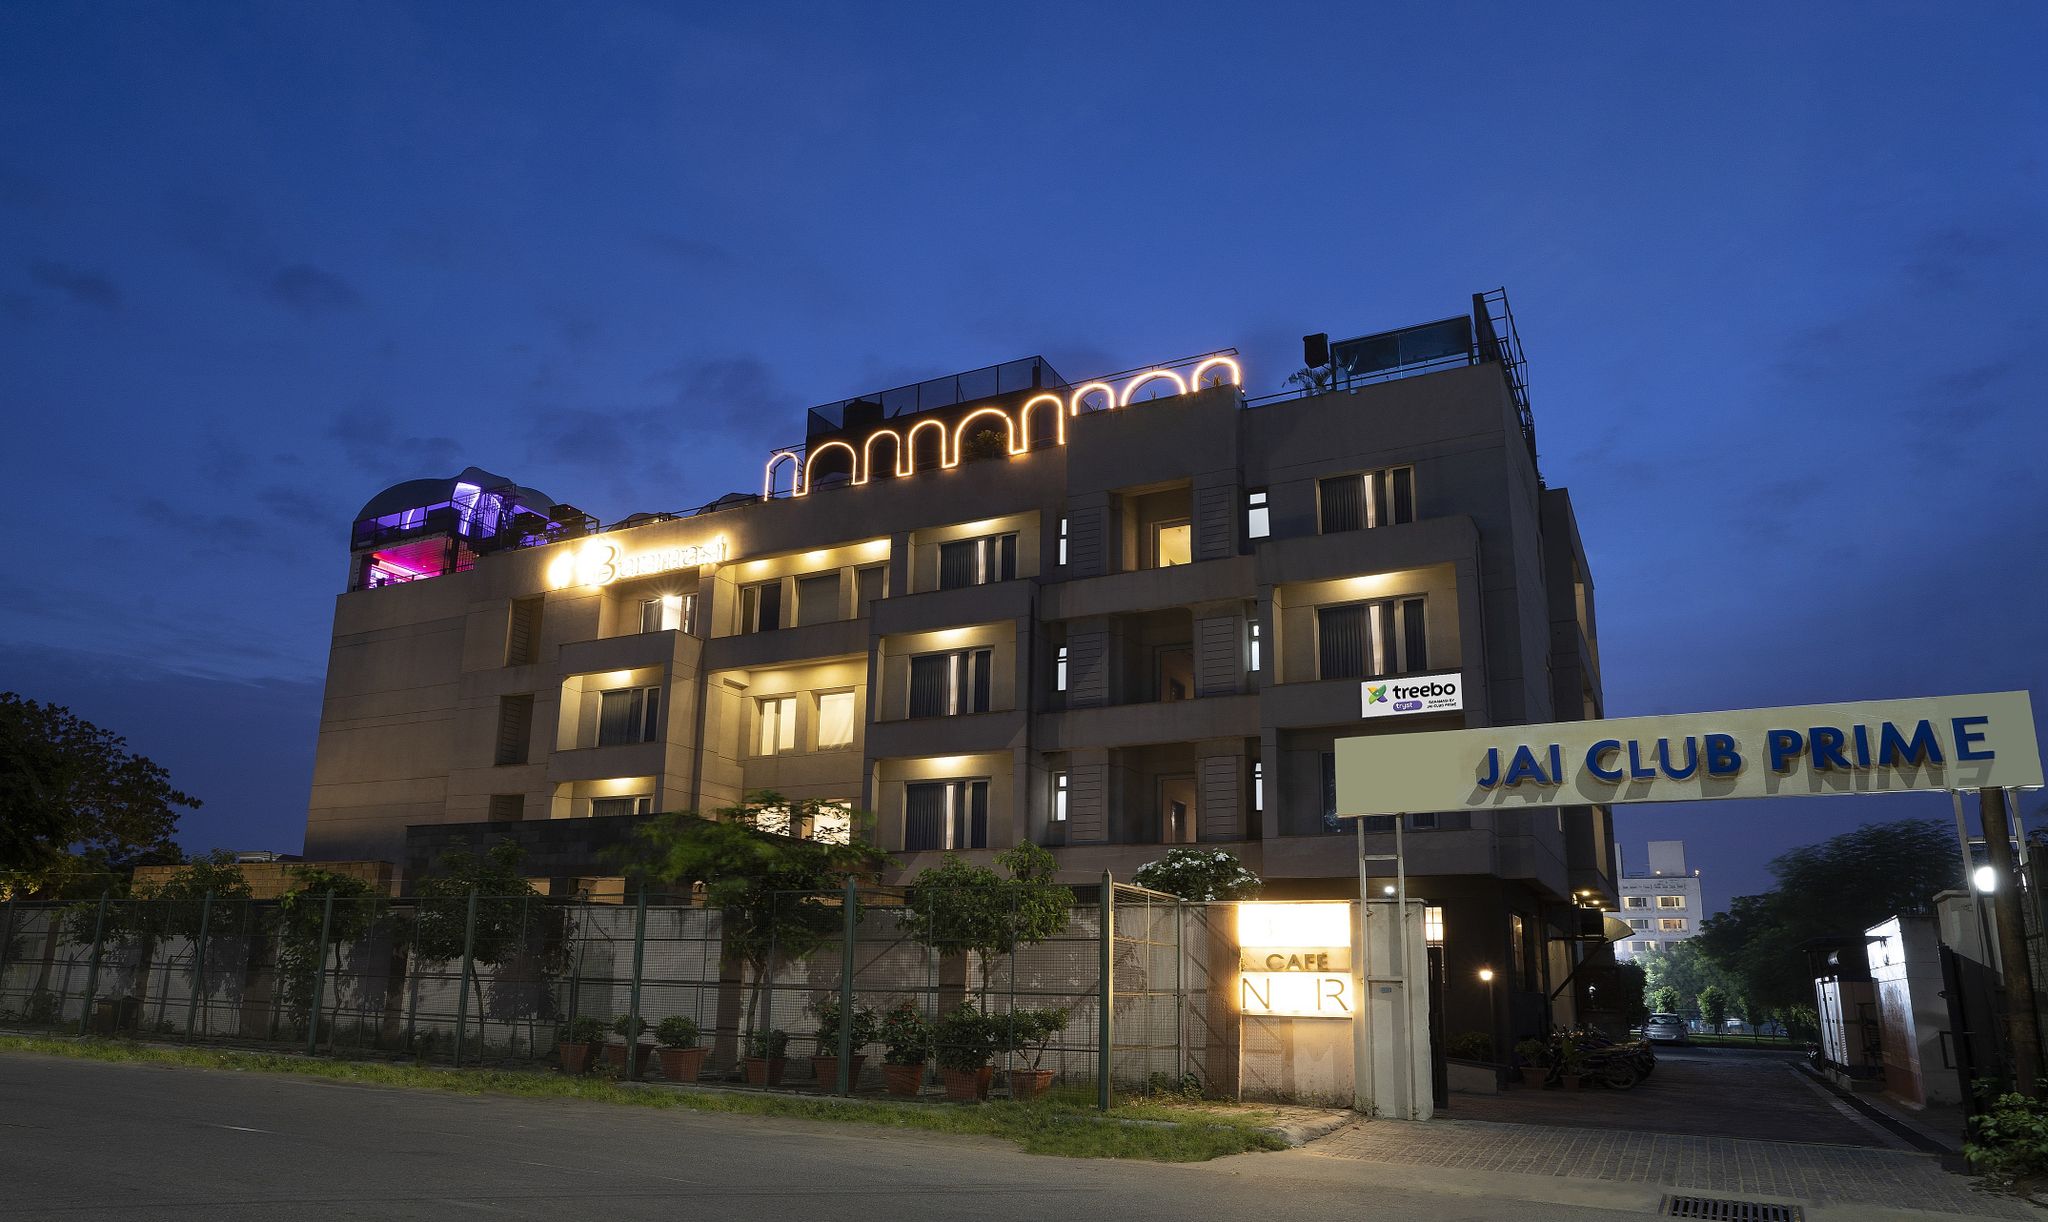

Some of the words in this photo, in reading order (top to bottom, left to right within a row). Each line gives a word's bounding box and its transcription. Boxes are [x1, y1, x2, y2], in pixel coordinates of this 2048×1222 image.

[1393, 682, 1456, 699] treebo
[1395, 702, 1413, 710] tryst
[1478, 745, 1564, 789] JAI
[1585, 734, 1743, 782] CLUB
[1767, 715, 1995, 772] PRIME
[1242, 977, 1349, 1011] NIR
